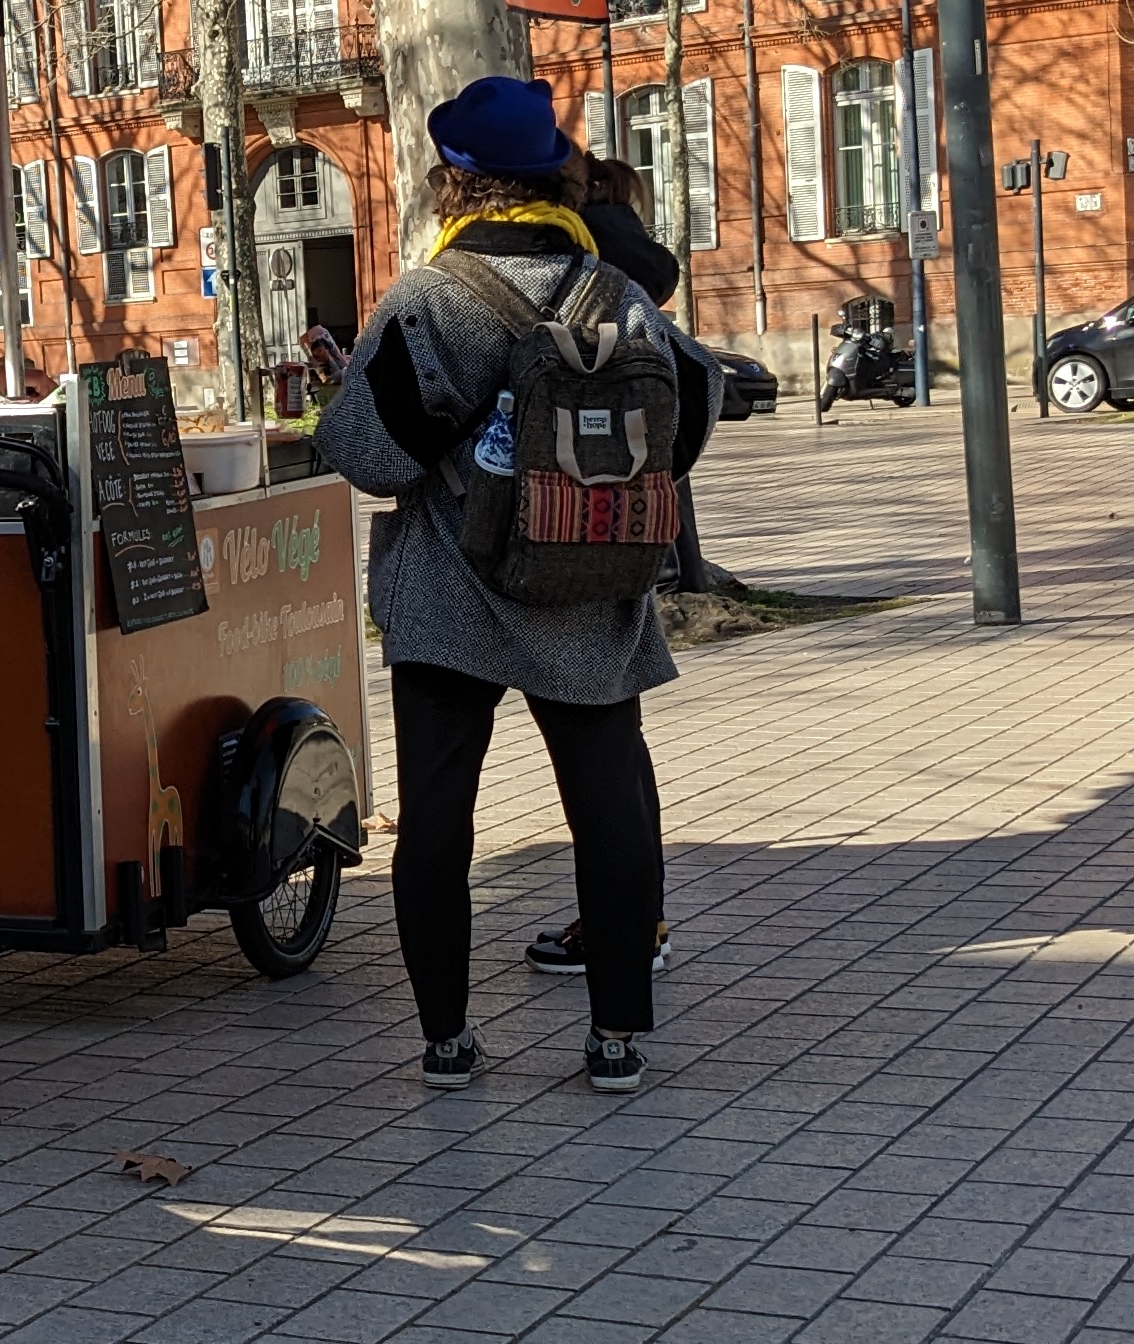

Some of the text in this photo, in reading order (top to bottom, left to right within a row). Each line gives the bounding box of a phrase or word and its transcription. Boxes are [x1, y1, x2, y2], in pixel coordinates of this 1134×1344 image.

[106, 366, 147, 402] Menu
[583, 415, 607, 423] hemp
[222, 525, 271, 585] Vélo
[271, 509, 321, 582] Végé
[279, 592, 345, 639] Toulousain
